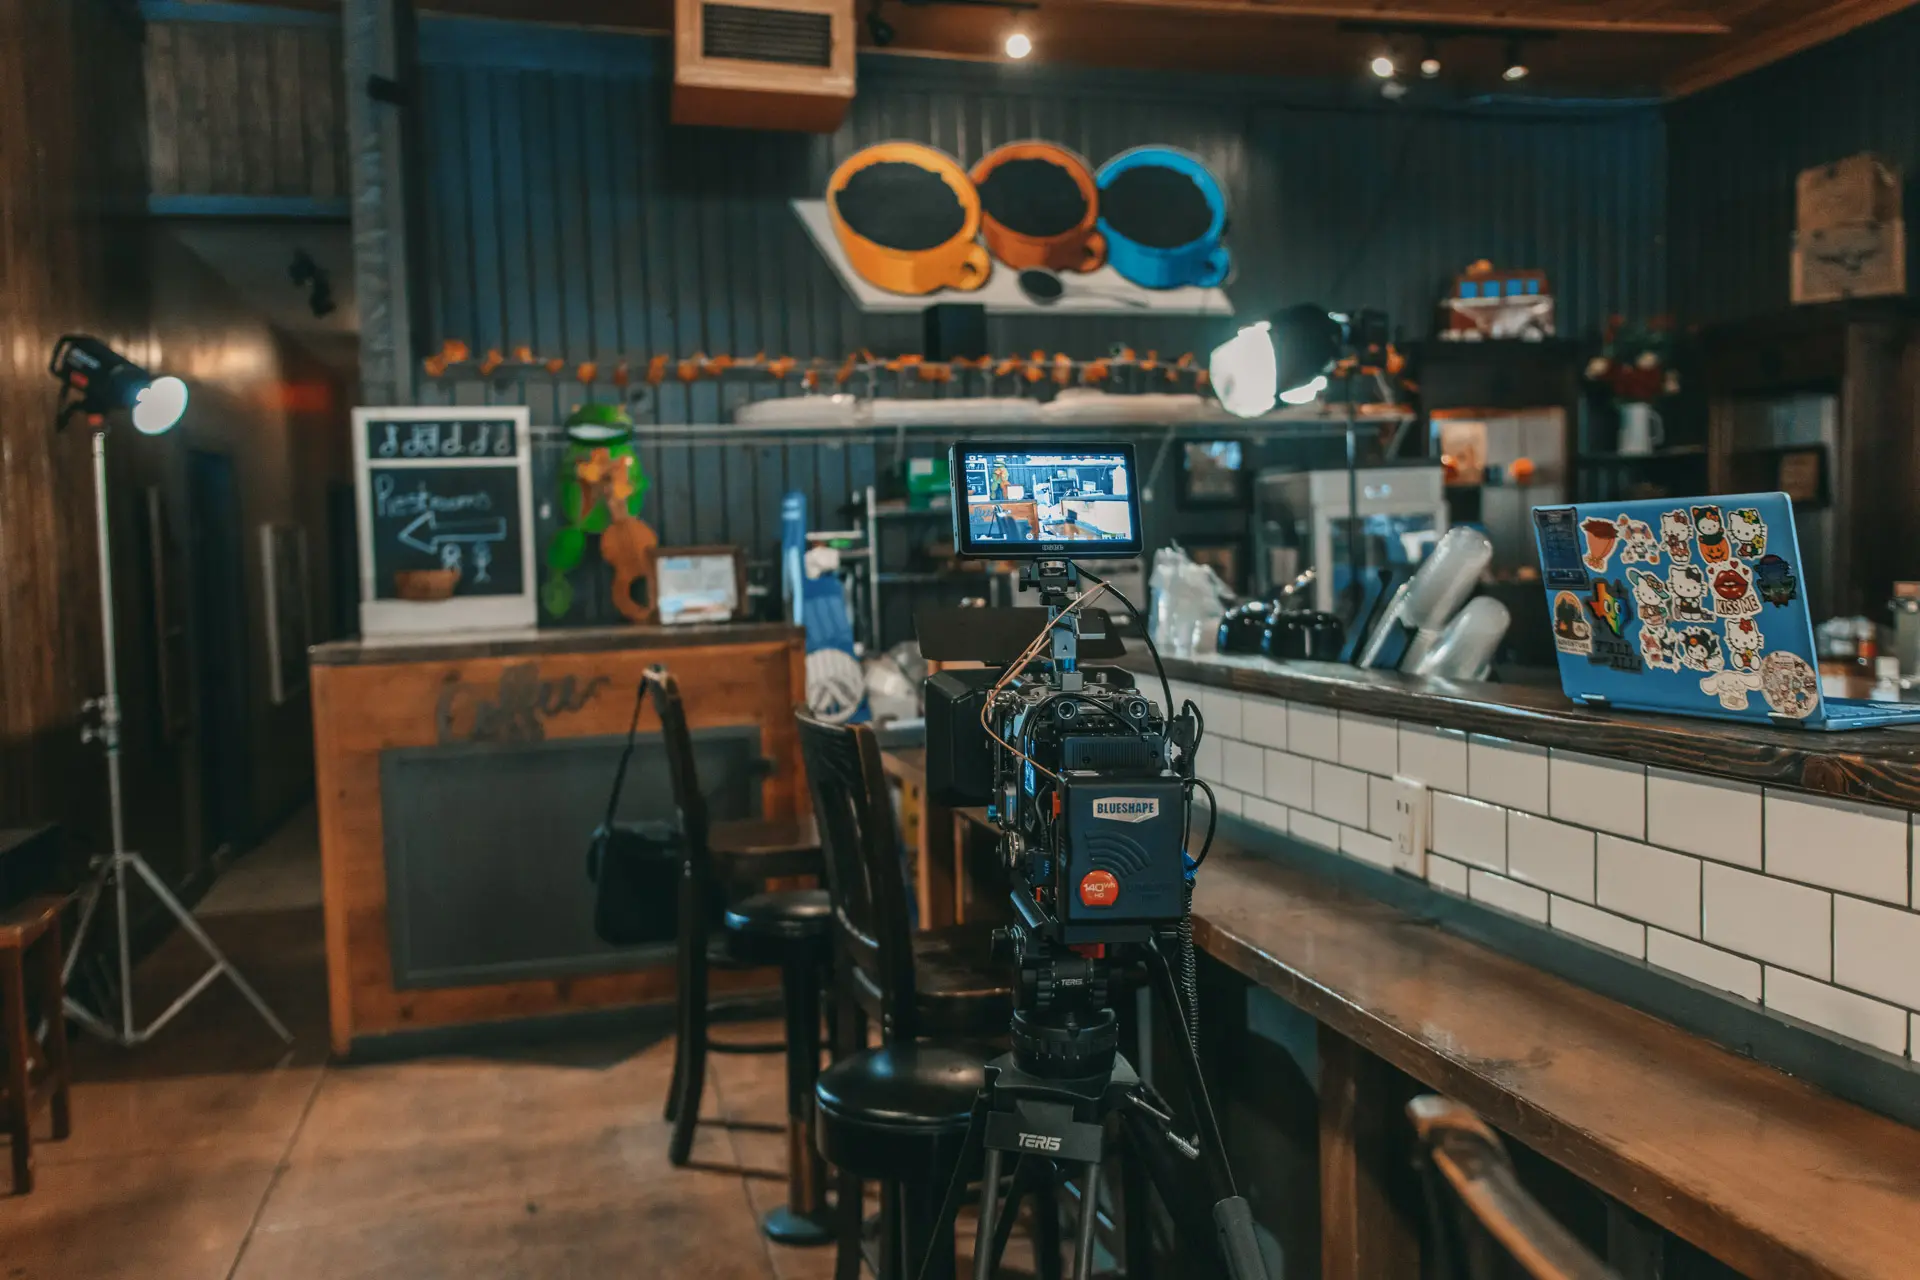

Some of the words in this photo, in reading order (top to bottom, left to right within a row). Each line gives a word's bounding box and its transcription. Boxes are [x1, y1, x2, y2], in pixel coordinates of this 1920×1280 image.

[1716, 598, 1740, 615] KISS
[1741, 595, 1759, 613] ME
[1096, 802, 1154, 814] BLUESHAPE
[1061, 978, 1083, 986] TERIS
[1018, 1132, 1063, 1151] TERIS
